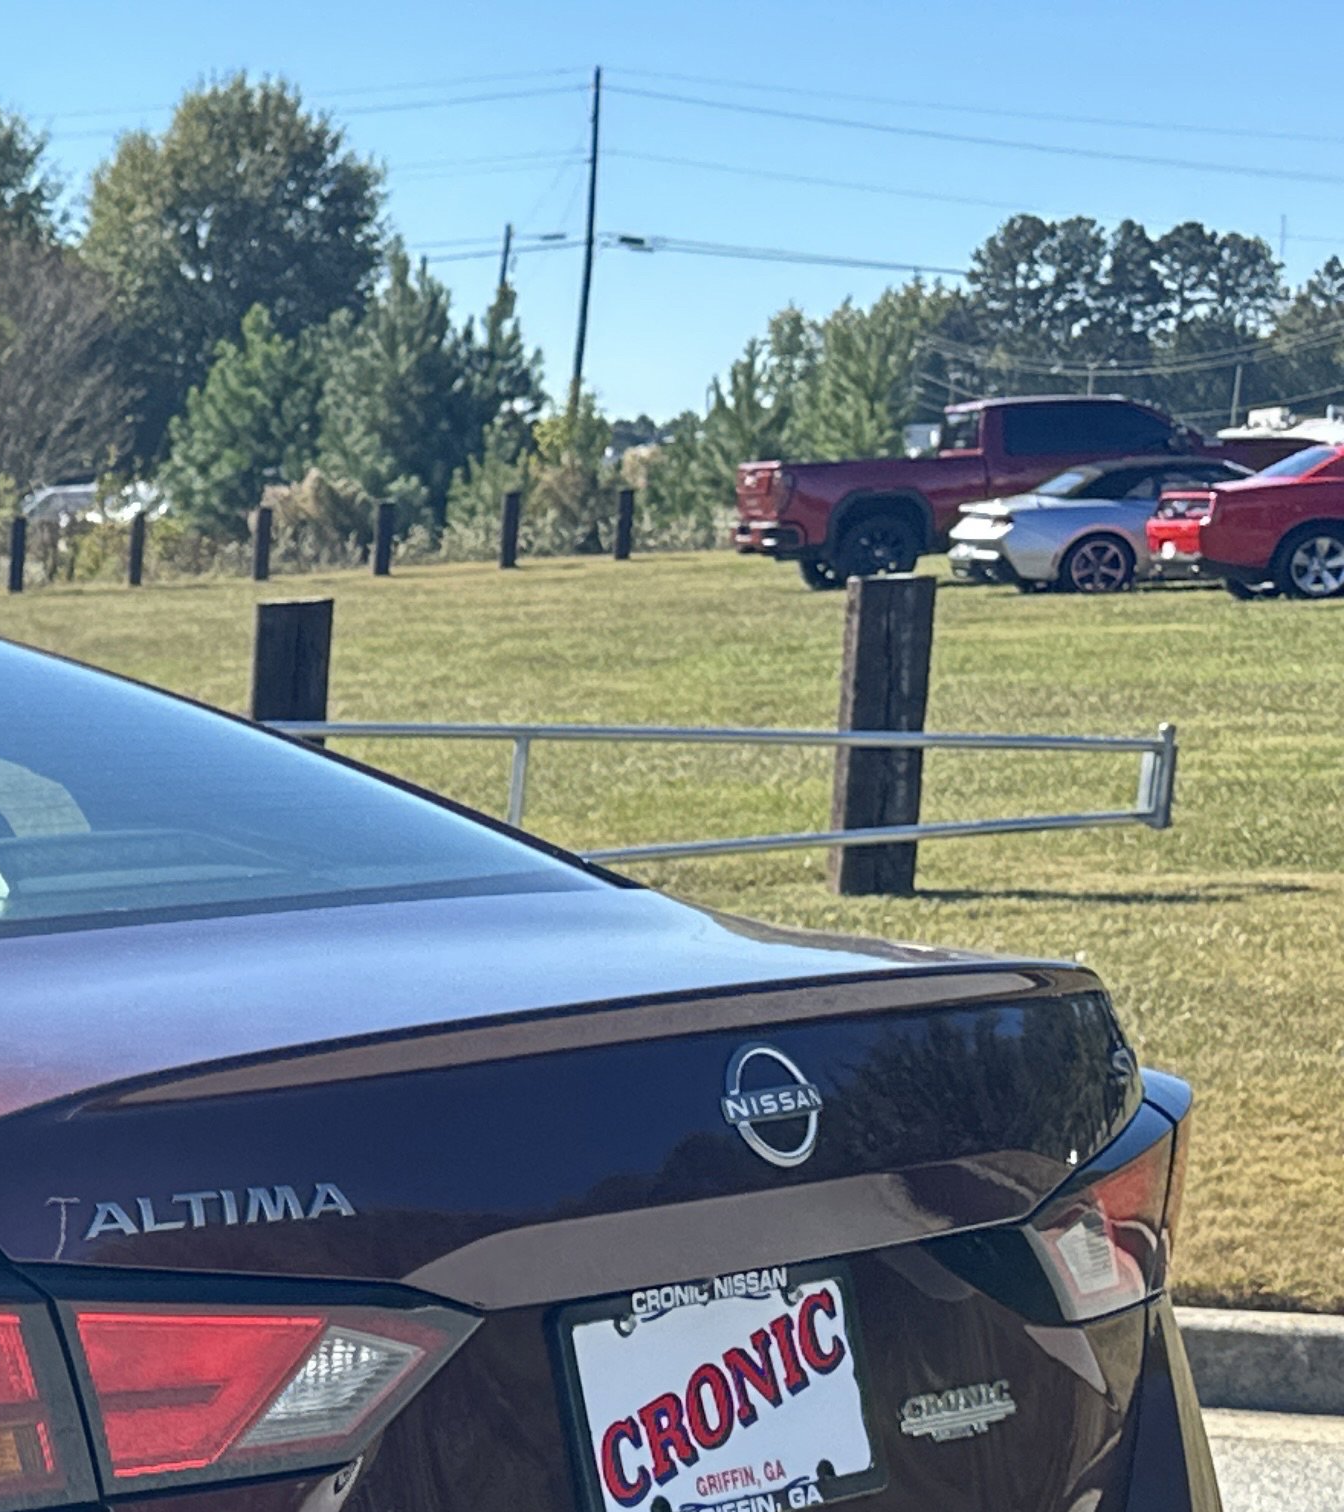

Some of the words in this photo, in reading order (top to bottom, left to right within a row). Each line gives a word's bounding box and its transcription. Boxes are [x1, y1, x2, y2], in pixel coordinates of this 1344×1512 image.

[725, 1087, 823, 1119] NISSAN
[83, 1182, 358, 1241] ALTIMA
[713, 1267, 788, 1300] NISSAN
[601, 1287, 846, 1509] CRONIC
[696, 1465, 762, 1497] GRIFFIN,
[763, 1459, 787, 1482] GA
[788, 1485, 824, 1510] GA
